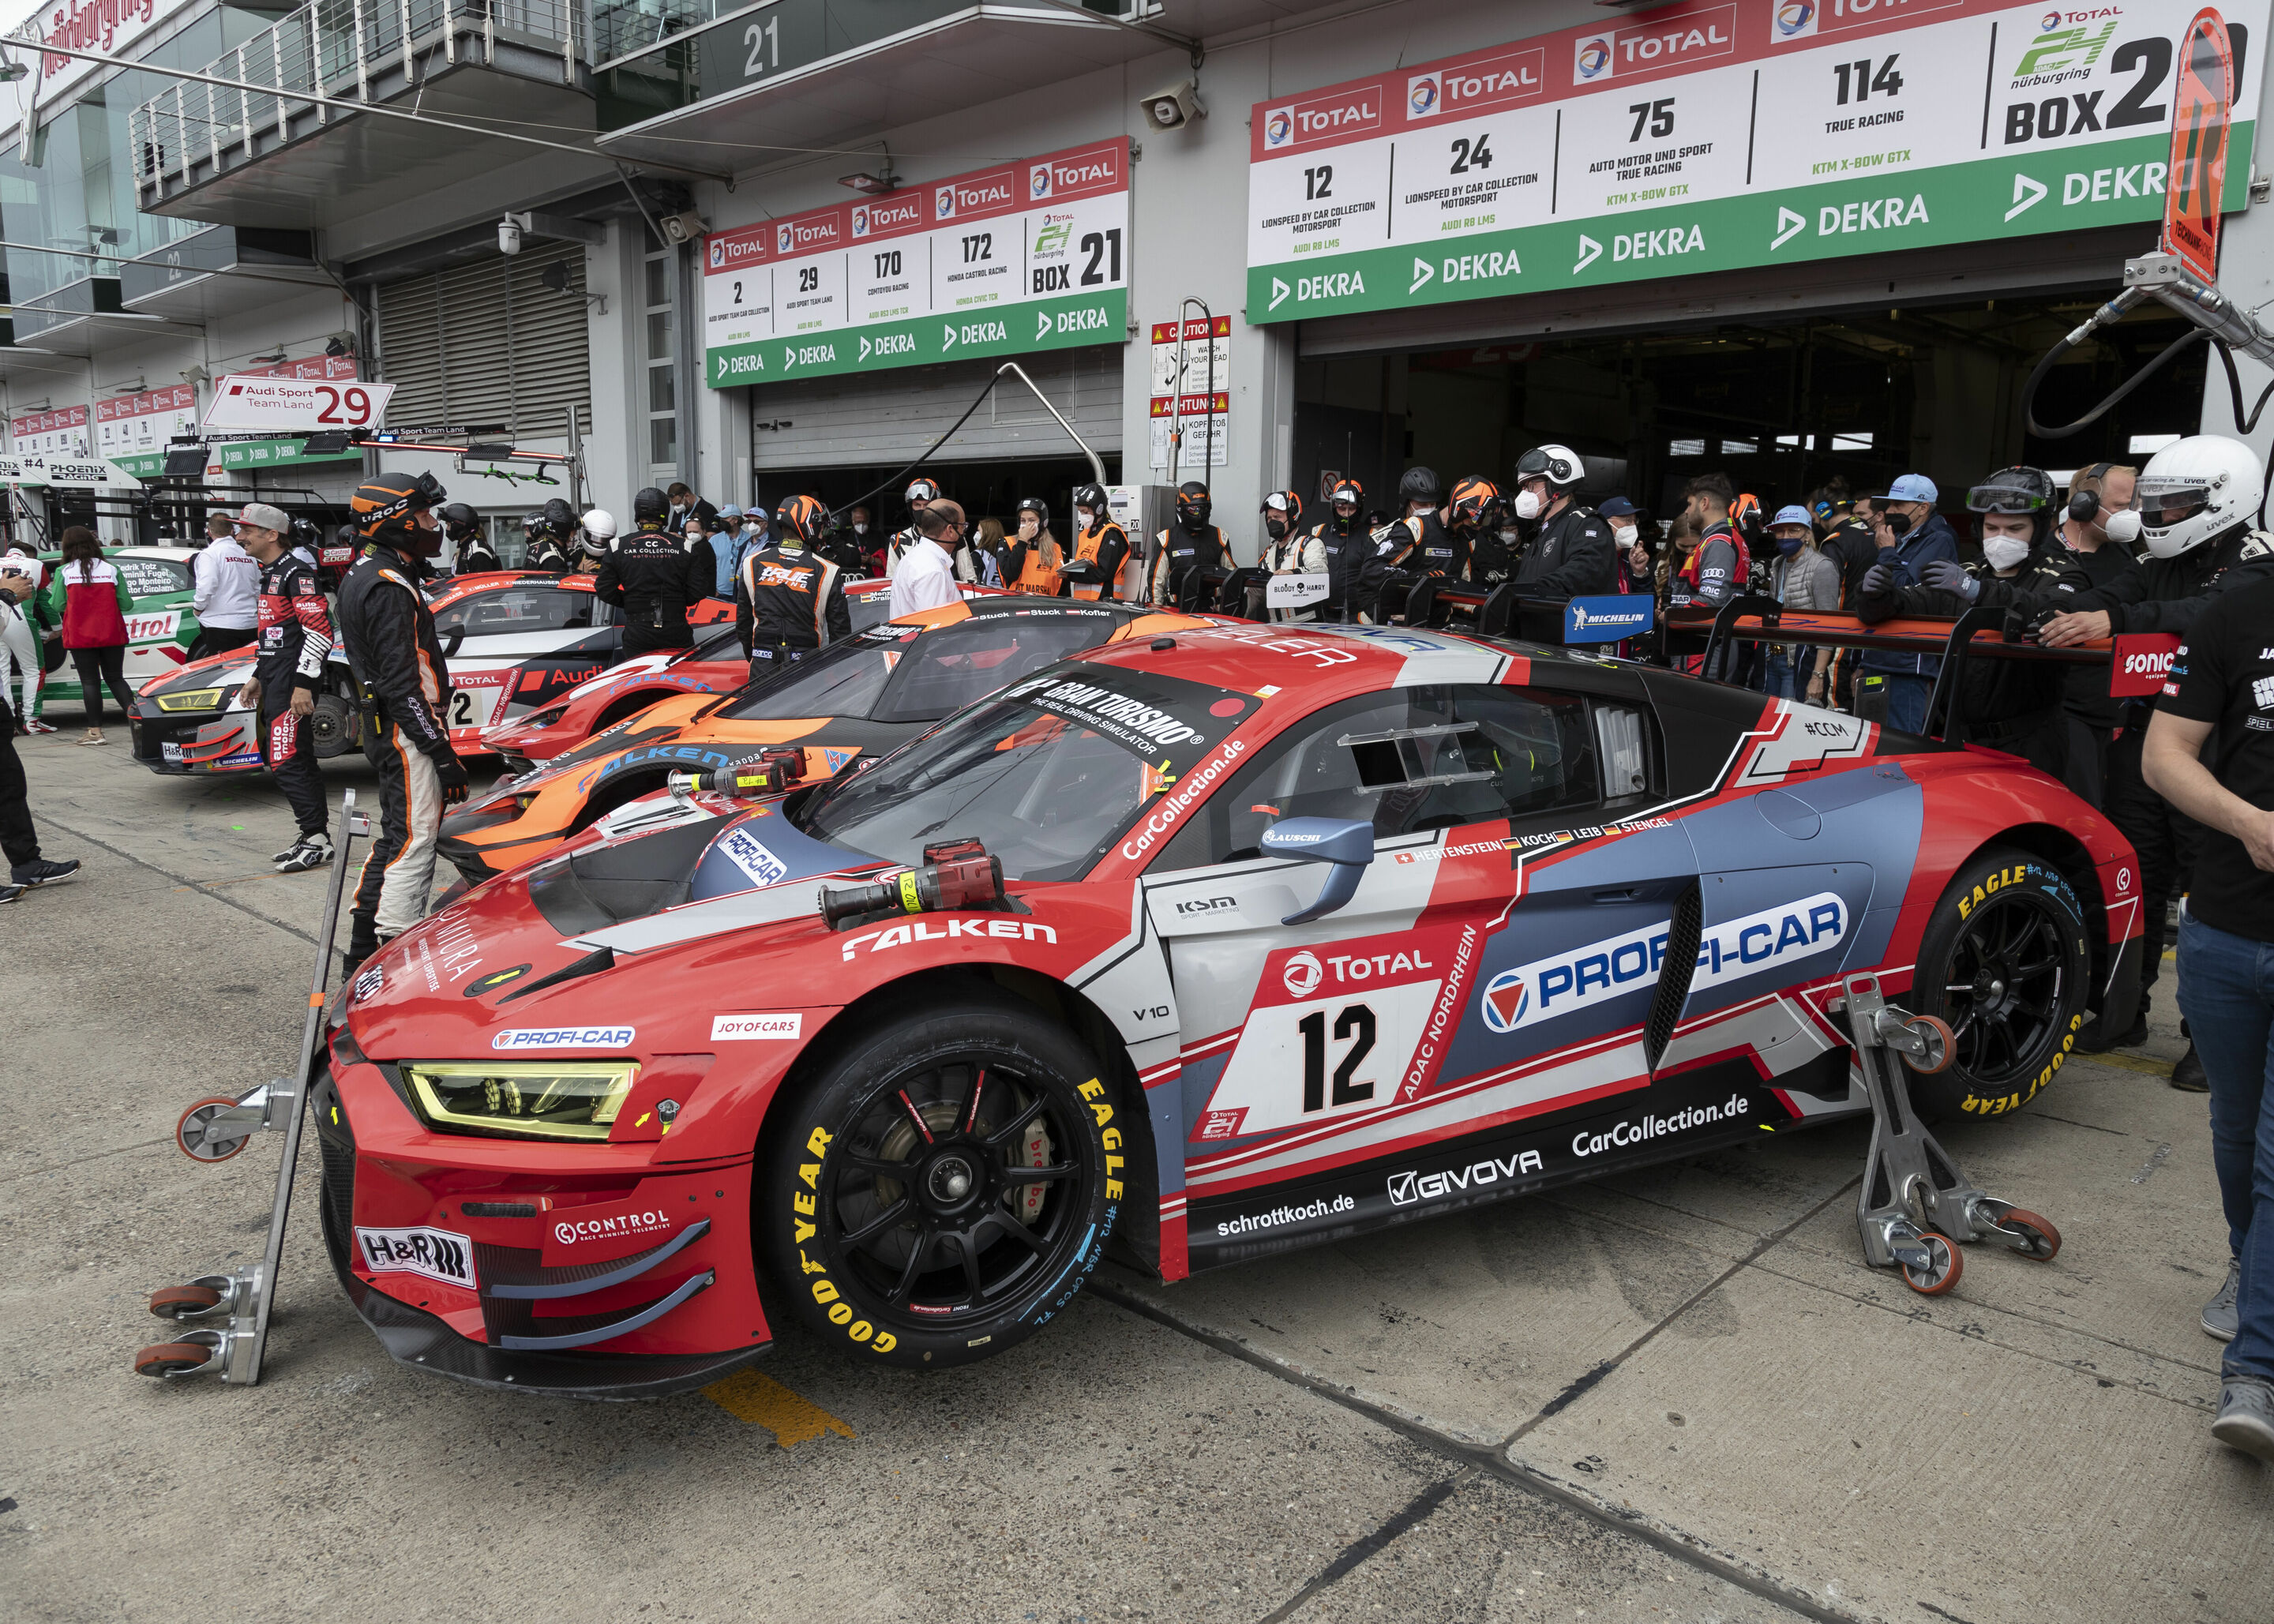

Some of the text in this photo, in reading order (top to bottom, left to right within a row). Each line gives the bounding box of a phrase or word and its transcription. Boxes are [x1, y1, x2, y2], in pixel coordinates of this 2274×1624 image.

[2066, 6, 2123, 24] TOTAL
[744, 15, 781, 77] 21
[1619, 24, 1728, 63] TOTAL
[1446, 66, 1538, 99] TOTAL
[1833, 52, 1904, 106] 114
[2010, 67, 2092, 90] nürburgring
[1297, 103, 1376, 133] TOTAL
[1628, 96, 1676, 143] 75
[1825, 110, 1904, 133] TRUE RACING
[2004, 89, 2105, 145] BOX
[1450, 133, 1492, 175] 24
[1589, 142, 1713, 174] AUTO MOTOR UND SPORT
[1812, 159, 1837, 175] KTM
[1887, 148, 1912, 164] GTX
[1054, 163, 1114, 186] TOTAL
[1304, 164, 1334, 201] 12
[1616, 161, 1683, 182] TRUE RACING
[958, 185, 1011, 208] TOTAL
[1405, 173, 1539, 205] LIONSPEED BY CAR COLLECTION
[1440, 192, 1499, 210] MOTORSPORT
[1606, 193, 1628, 206] KTM
[1668, 183, 1690, 197] GTX
[871, 203, 919, 227] TOTAL
[1053, 213, 1075, 223] TOTAL
[1261, 201, 1376, 229] LIONSPEED BY CAR COLLECTION
[1292, 218, 1342, 234] MOTORSPORT
[1441, 213, 1496, 231] AUDI R8 LMS
[1818, 193, 1930, 237] DEKRA
[795, 224, 837, 243] TOTAL
[1612, 224, 1706, 262] DEKRA
[726, 240, 764, 258] TOTAL
[962, 232, 992, 264] 172
[167, 250, 182, 282] 22
[874, 250, 902, 279] 170
[1033, 227, 1121, 294] BOX 21
[1443, 249, 1522, 283] DEKRA
[799, 266, 819, 292] 29
[948, 265, 1008, 283] HONDA CASTROL RACING
[1297, 270, 1365, 302] DEKRA
[734, 281, 742, 304] 2
[892, 282, 910, 292] RACING
[1057, 306, 1109, 333] DEKRA
[875, 332, 916, 356] DEKRA
[961, 321, 1008, 345] DEKRA
[731, 354, 764, 374] DEKRA
[799, 343, 836, 366] DEKRA
[303, 366, 321, 377] TOTAL
[334, 361, 353, 373] TOTAL
[246, 386, 314, 398] Audi Sport
[247, 398, 313, 410] Team Land
[315, 385, 371, 426] 29
[400, 427, 423, 436] Sport
[1188, 418, 1226, 429] KOPFTOß
[230, 451, 243, 462] DEKRA
[254, 448, 269, 459] DEKRA
[281, 445, 296, 456] DEKRA
[24, 458, 45, 469] #4
[1131, 519, 1140, 531] 20
[2205, 512, 2236, 532] uvex
[474, 581, 500, 591] MÜLLER
[759, 576, 808, 590] RACING
[1274, 583, 1326, 593] BLOODY HARRY
[979, 612, 1009, 621] Stuck
[1080, 609, 1111, 617] Kofler
[1587, 613, 1645, 624] MICHELIN
[456, 676, 500, 685] TOTAL
[609, 673, 714, 696] FALKEN
[492, 669, 518, 726] ADAC NORDRHEIN
[1047, 681, 1196, 745] GRAN TURISMO
[1030, 698, 1158, 756] THE REAL DRIVING SIMULATOR
[1804, 722, 1848, 737] #CCM
[222, 756, 258, 765] MICHELIN
[512, 719, 633, 786] READY TO RACE
[578, 745, 730, 794] FALKEN
[1122, 739, 1245, 861] CarCollection.de
[1414, 817, 1674, 863] HERTENSTEIN KOCH LEIB STENGEL
[726, 831, 784, 885] PROFI-CAR
[1176, 896, 1237, 913] KSM
[1957, 865, 2026, 921] EAGLE
[1205, 907, 1240, 917] MARKETING
[434, 916, 483, 983] MIURA
[842, 918, 1058, 962] FALKEN
[1327, 950, 1432, 982] TOTAL
[1538, 902, 1842, 1009] PROFI-CAR
[1403, 924, 1477, 1101] ADAC NORDRHEIN
[513, 1030, 632, 1046] PROFI-CAR
[1297, 1002, 1379, 1116] 12
[2039, 1014, 2082, 1088] GOOD
[1960, 1092, 2021, 1116] YEAR
[1572, 1093, 1748, 1158] CarCollection.de
[1076, 1078, 1124, 1202] EAGLE
[793, 1126, 834, 1245] YEAR
[1417, 1150, 1543, 1199] GIVOVA
[577, 1210, 670, 1235] CONTROL
[1218, 1194, 1355, 1237] schrottkoch.de
[580, 1222, 671, 1243] RACE WINNING TELEMETRY
[812, 1279, 897, 1354] GOOD
